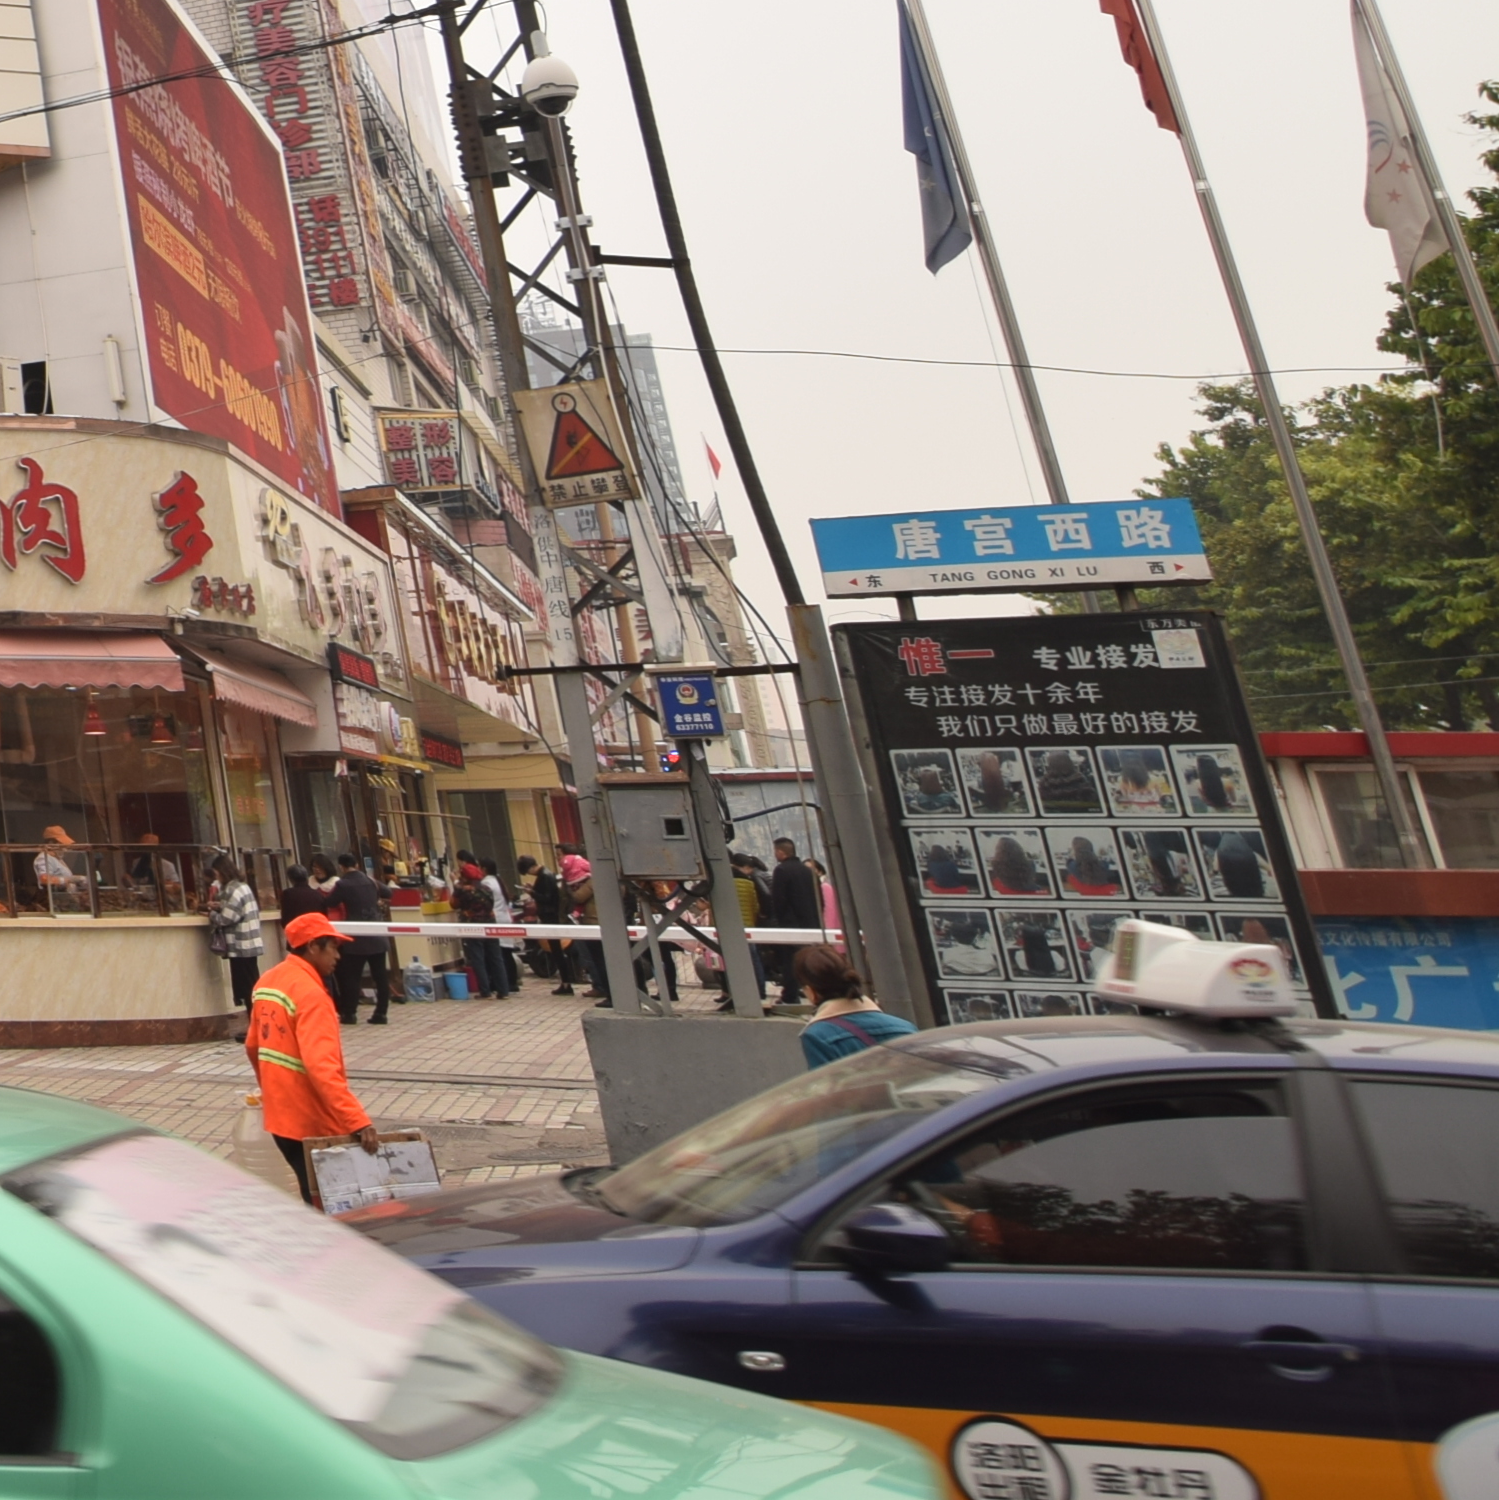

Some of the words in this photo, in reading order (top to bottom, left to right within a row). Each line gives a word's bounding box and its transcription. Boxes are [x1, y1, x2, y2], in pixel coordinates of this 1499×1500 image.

[385, 421, 455, 451] 整形
[390, 456, 458, 485] 美容
[549, 474, 629, 500] 禁止攀登
[893, 508, 1173, 561] 唐宫西路
[533, 513, 571, 620] 洛供中唐线
[554, 626, 573, 642] 15
[865, 574, 884, 589] 东
[929, 570, 977, 585] TANG
[986, 567, 1038, 582] GONG
[1048, 566, 1067, 579] XI
[1077, 564, 1099, 578] LU
[1148, 560, 1167, 576] 西
[898, 636, 995, 677] 惟一
[1032, 642, 1160, 671] 专业接发
[904, 681, 1104, 707] 专注接发十余年
[674, 713, 713, 723] 金谷监控
[675, 722, 714, 732] 63377110
[936, 709, 1203, 739] 我们只做最好的接发
[967, 1441, 1043, 1472] 洛阳
[1089, 1462, 1213, 1500] 金牡丹
